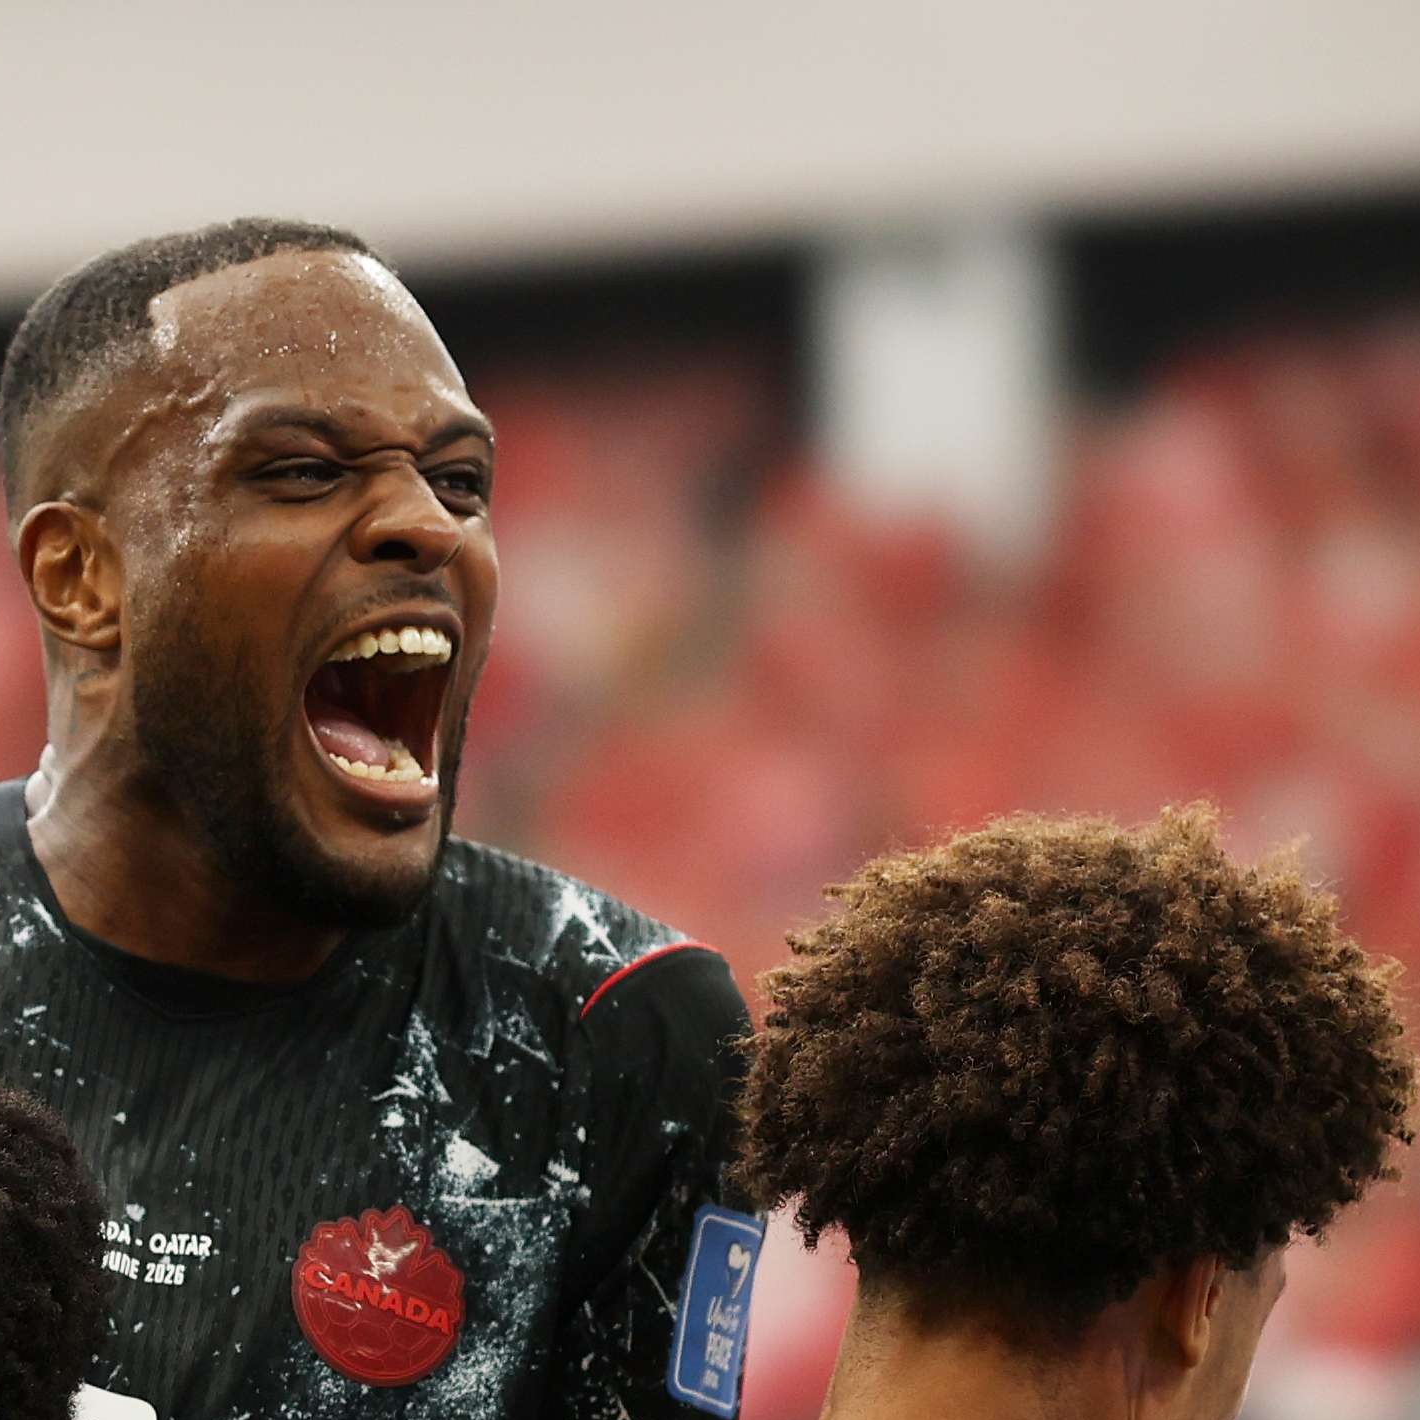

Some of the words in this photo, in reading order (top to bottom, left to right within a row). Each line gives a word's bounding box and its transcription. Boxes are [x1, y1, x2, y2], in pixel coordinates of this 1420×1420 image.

[149, 1233, 212, 1257] QATAR
[144, 1262, 186, 1286] 2026
[303, 1262, 452, 1336] CANADA
